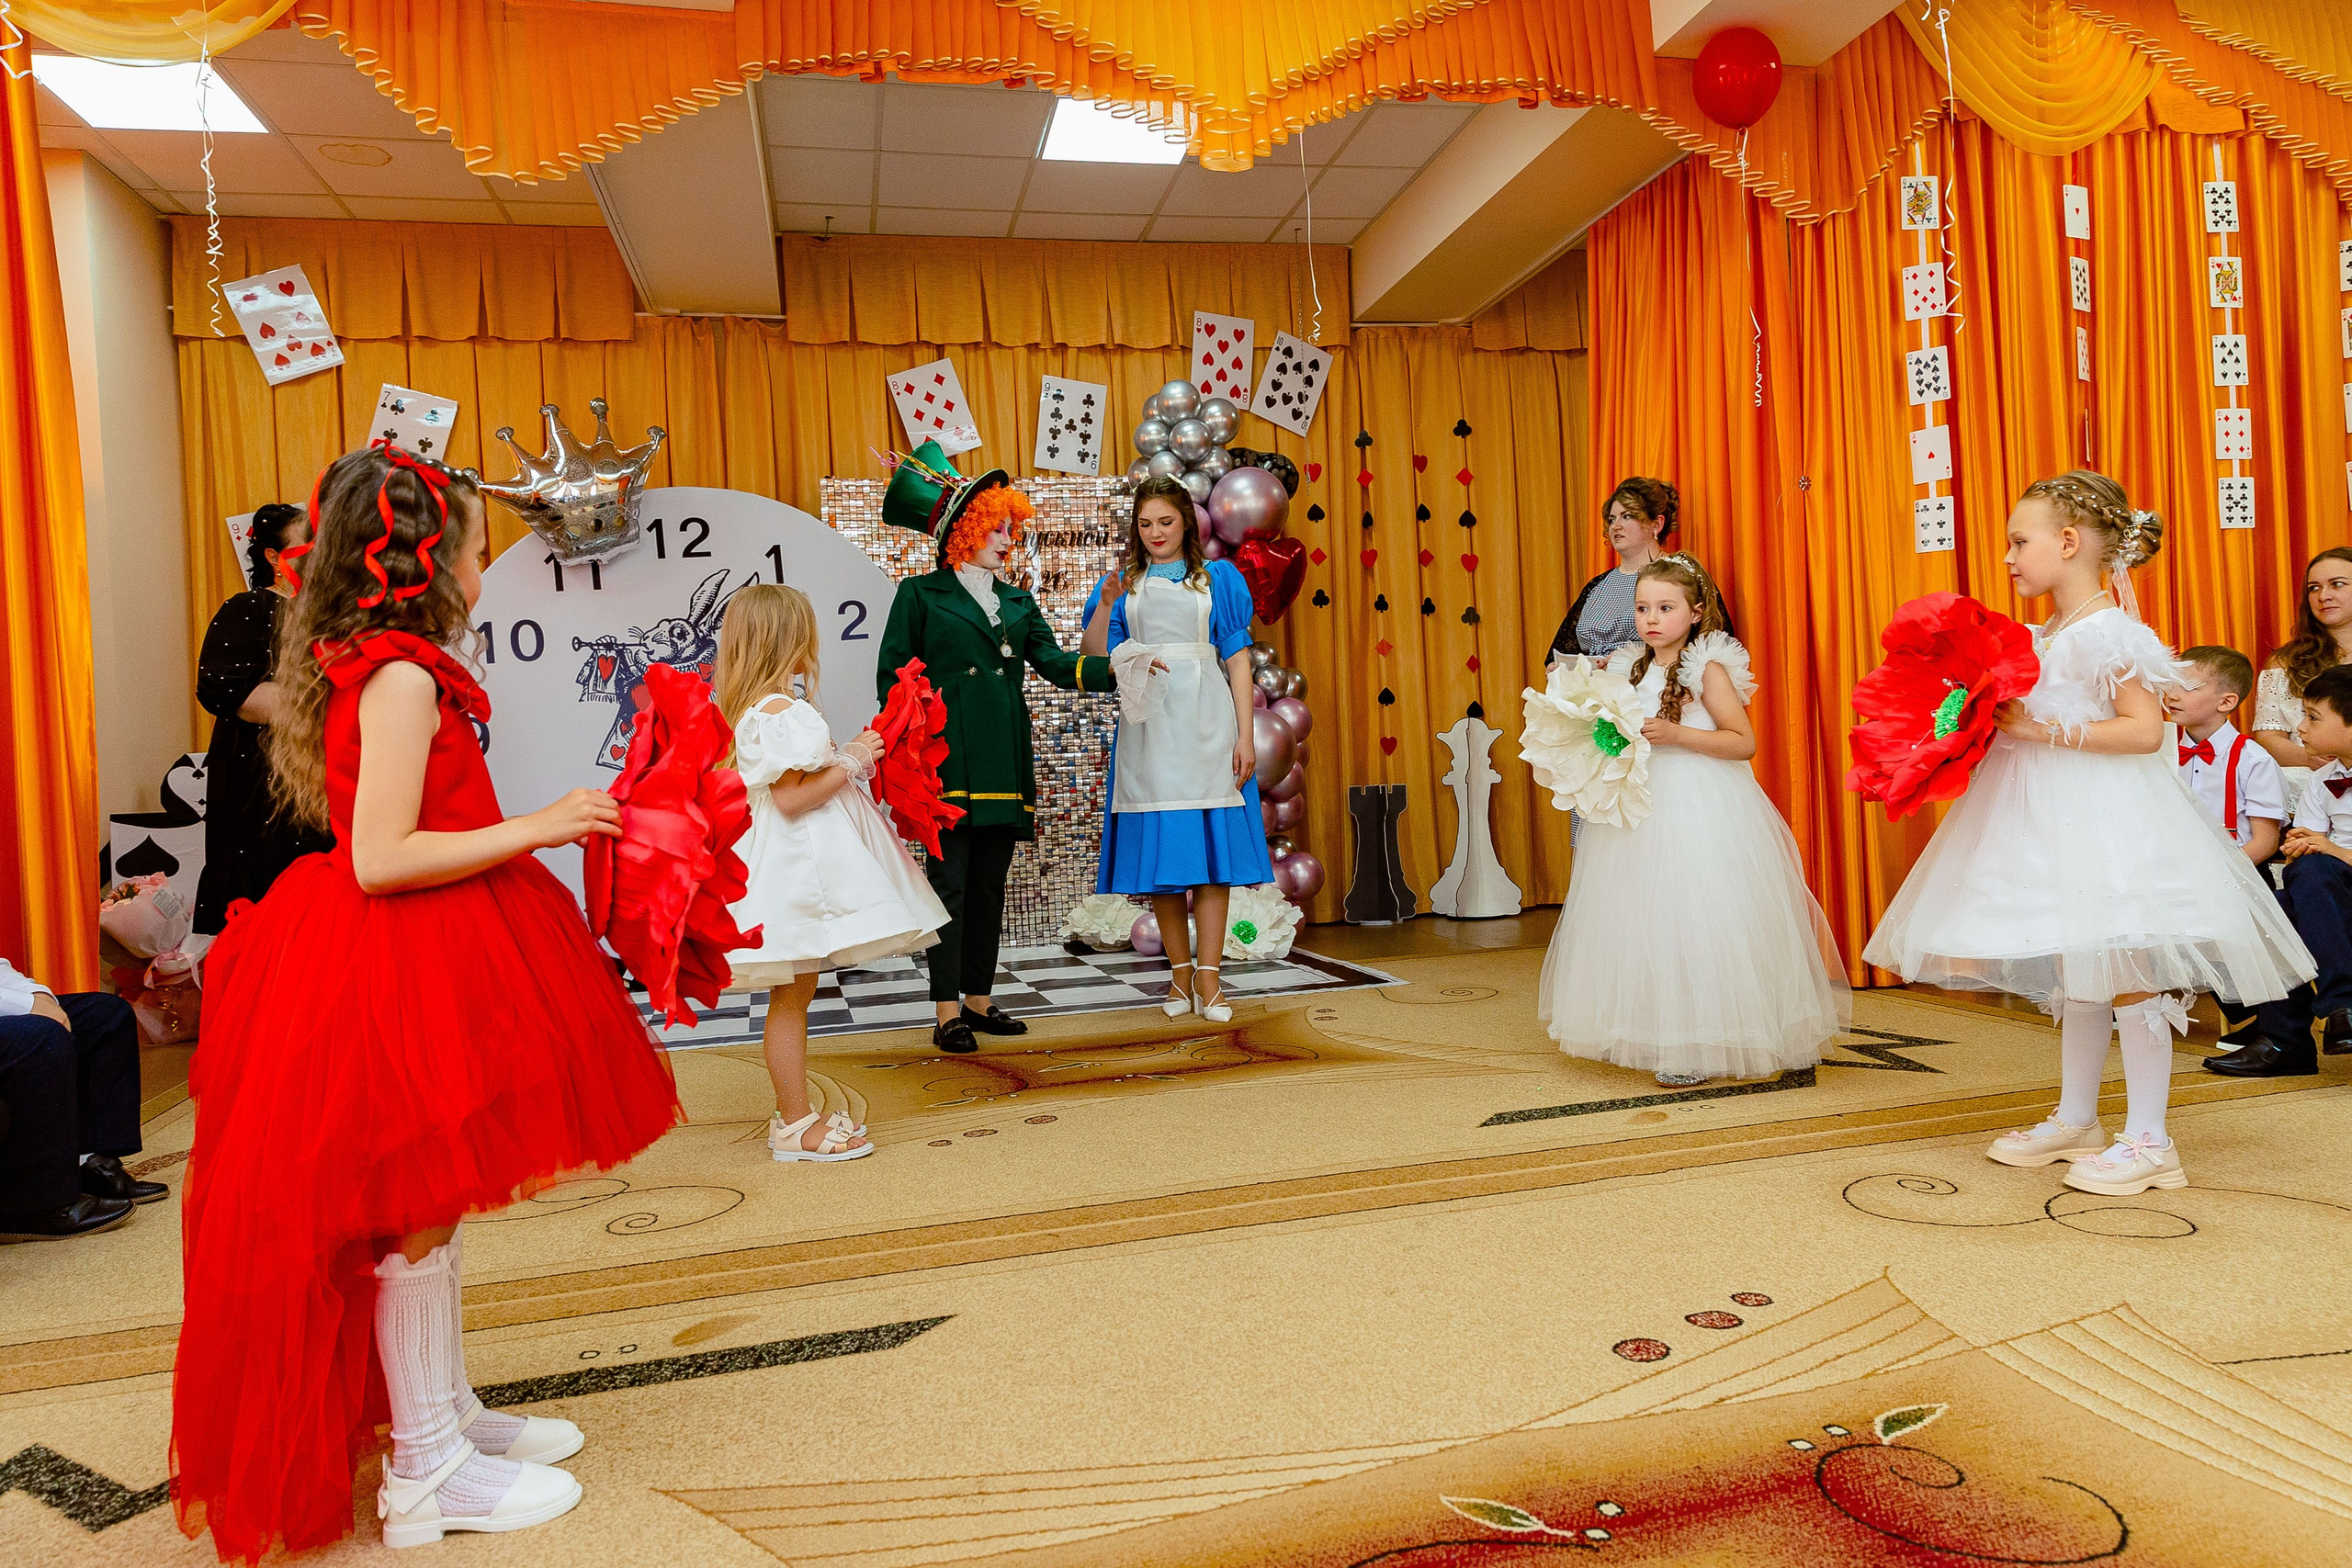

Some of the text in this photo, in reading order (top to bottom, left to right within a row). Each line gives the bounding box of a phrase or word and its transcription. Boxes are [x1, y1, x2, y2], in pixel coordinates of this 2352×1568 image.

[1196, 317, 1203, 327] 8
[1276, 335, 1284, 346] 10
[892, 381, 899, 390] 8
[1045, 382, 1051, 392] 9
[383, 390, 391, 400] 7
[1242, 394, 1249, 403] 8
[232, 523, 240, 535] 9
[646, 517, 712, 559] 12
[764, 544, 785, 584] 1
[544, 553, 603, 592] 11
[1004, 569, 1069, 594] 2026
[837, 600, 869, 641] 2
[477, 619, 545, 664] 10
